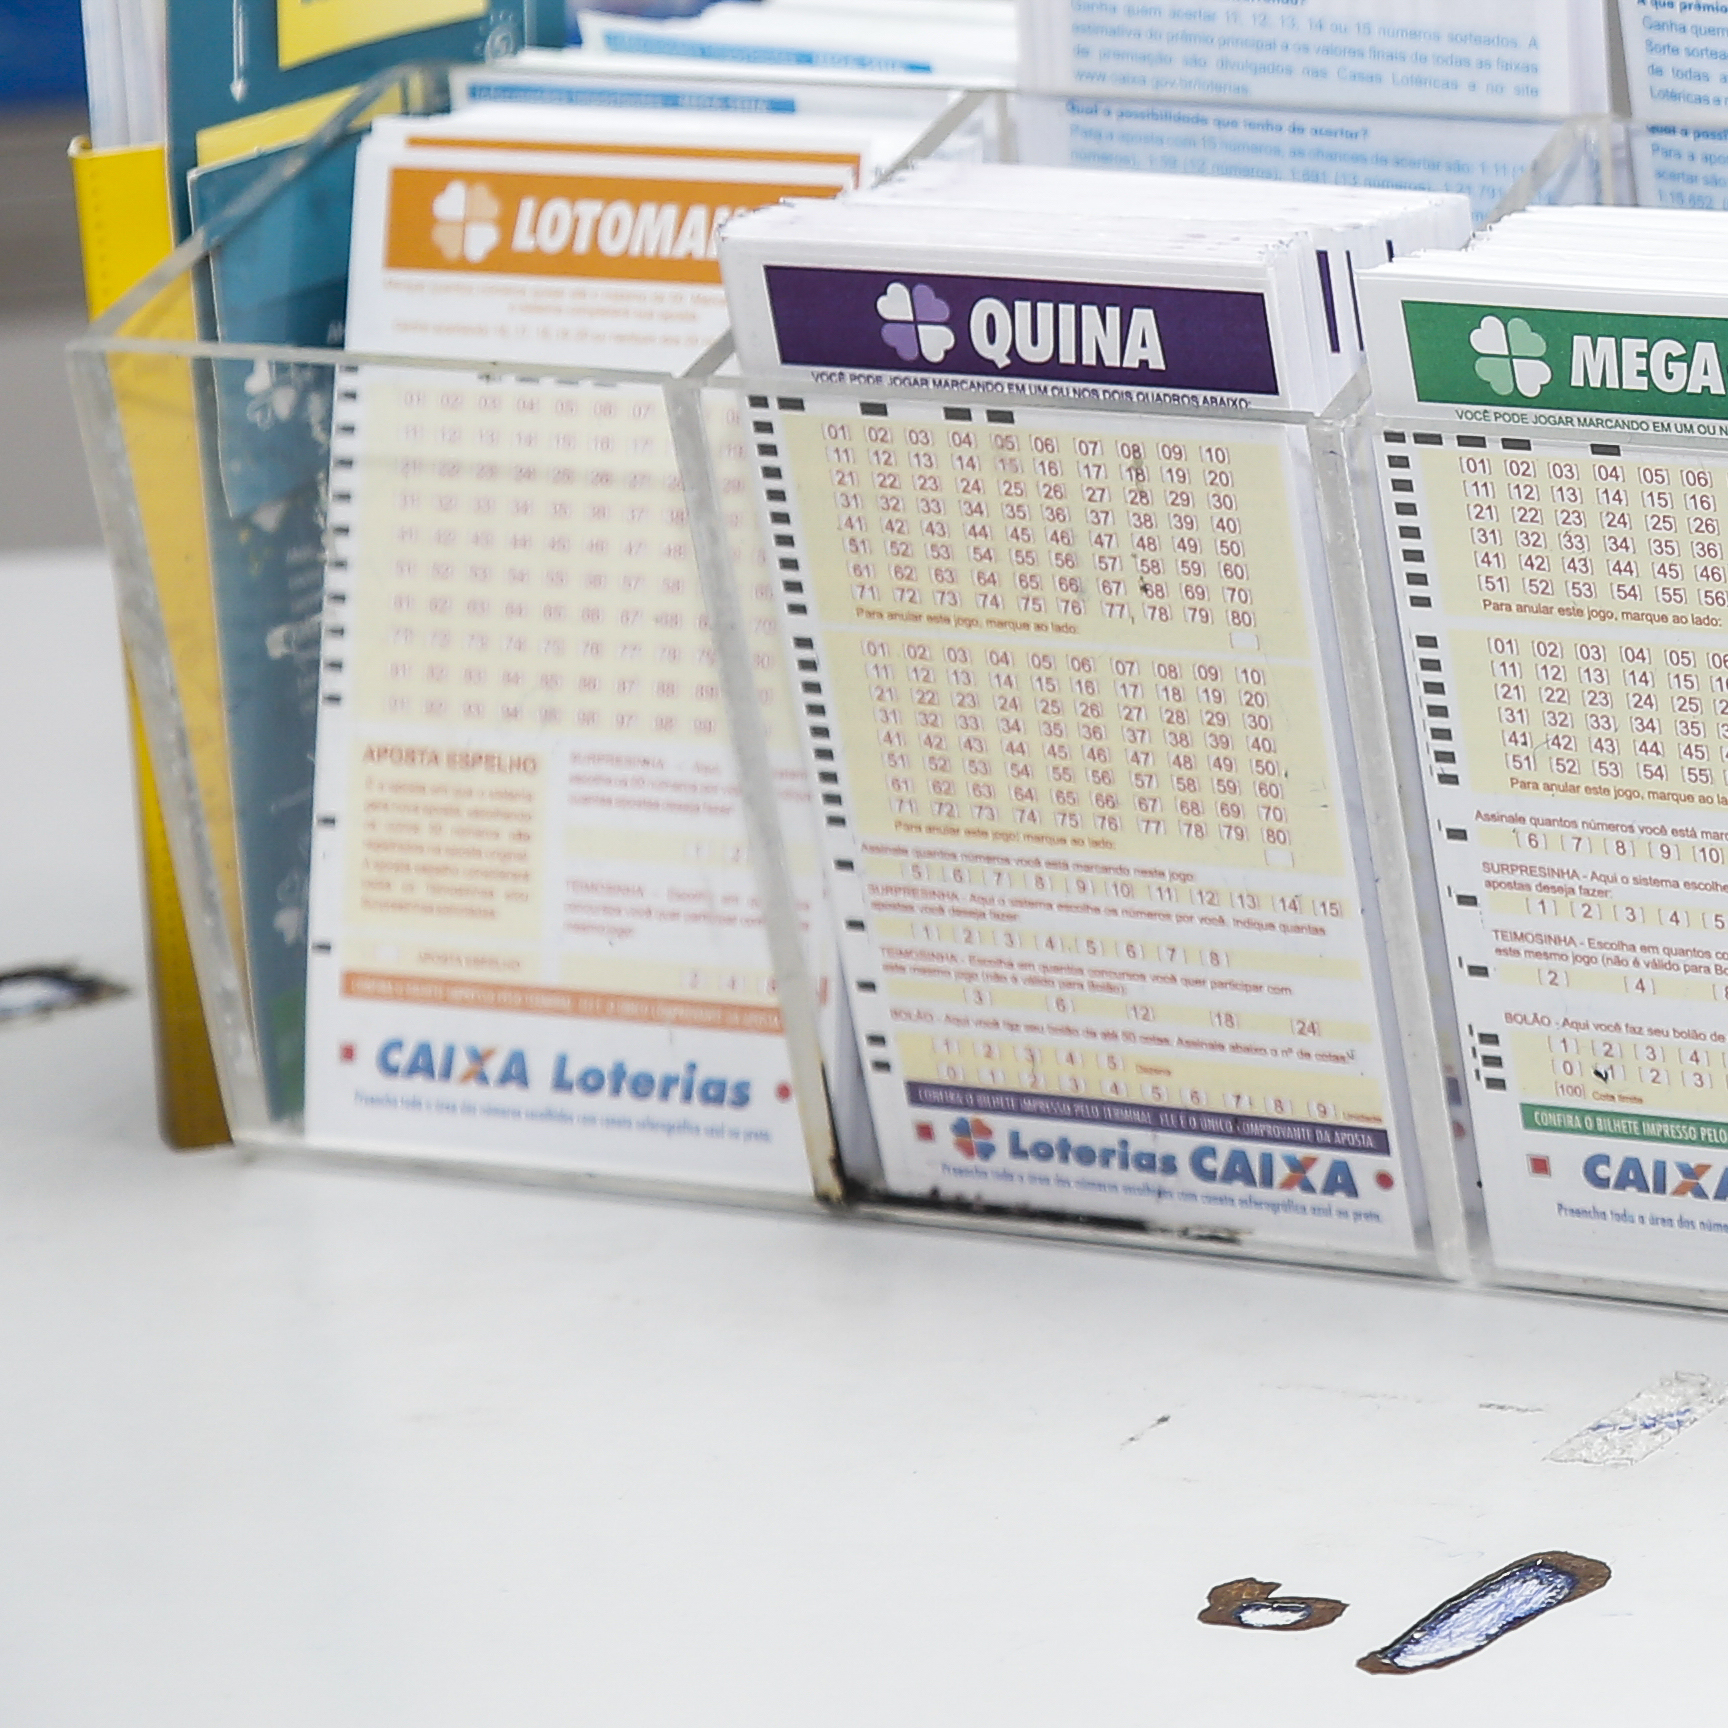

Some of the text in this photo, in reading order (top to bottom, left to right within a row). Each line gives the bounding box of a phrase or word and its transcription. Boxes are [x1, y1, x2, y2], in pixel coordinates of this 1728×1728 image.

[970, 296, 1166, 371] QUINA
[1456, 408, 1491, 422] VOCÊ
[1494, 411, 1528, 424] PODE
[1531, 414, 1574, 428] JOGAR
[1576, 417, 1649, 432] MARCANDO
[1653, 421, 1672, 433] EM
[1675, 423, 1694, 434] UM
[1697, 423, 1717, 435] OU
[376, 1038, 753, 1108] CAIXA Loterias
[1009, 1131, 1358, 1198] Loterias CAIXA
